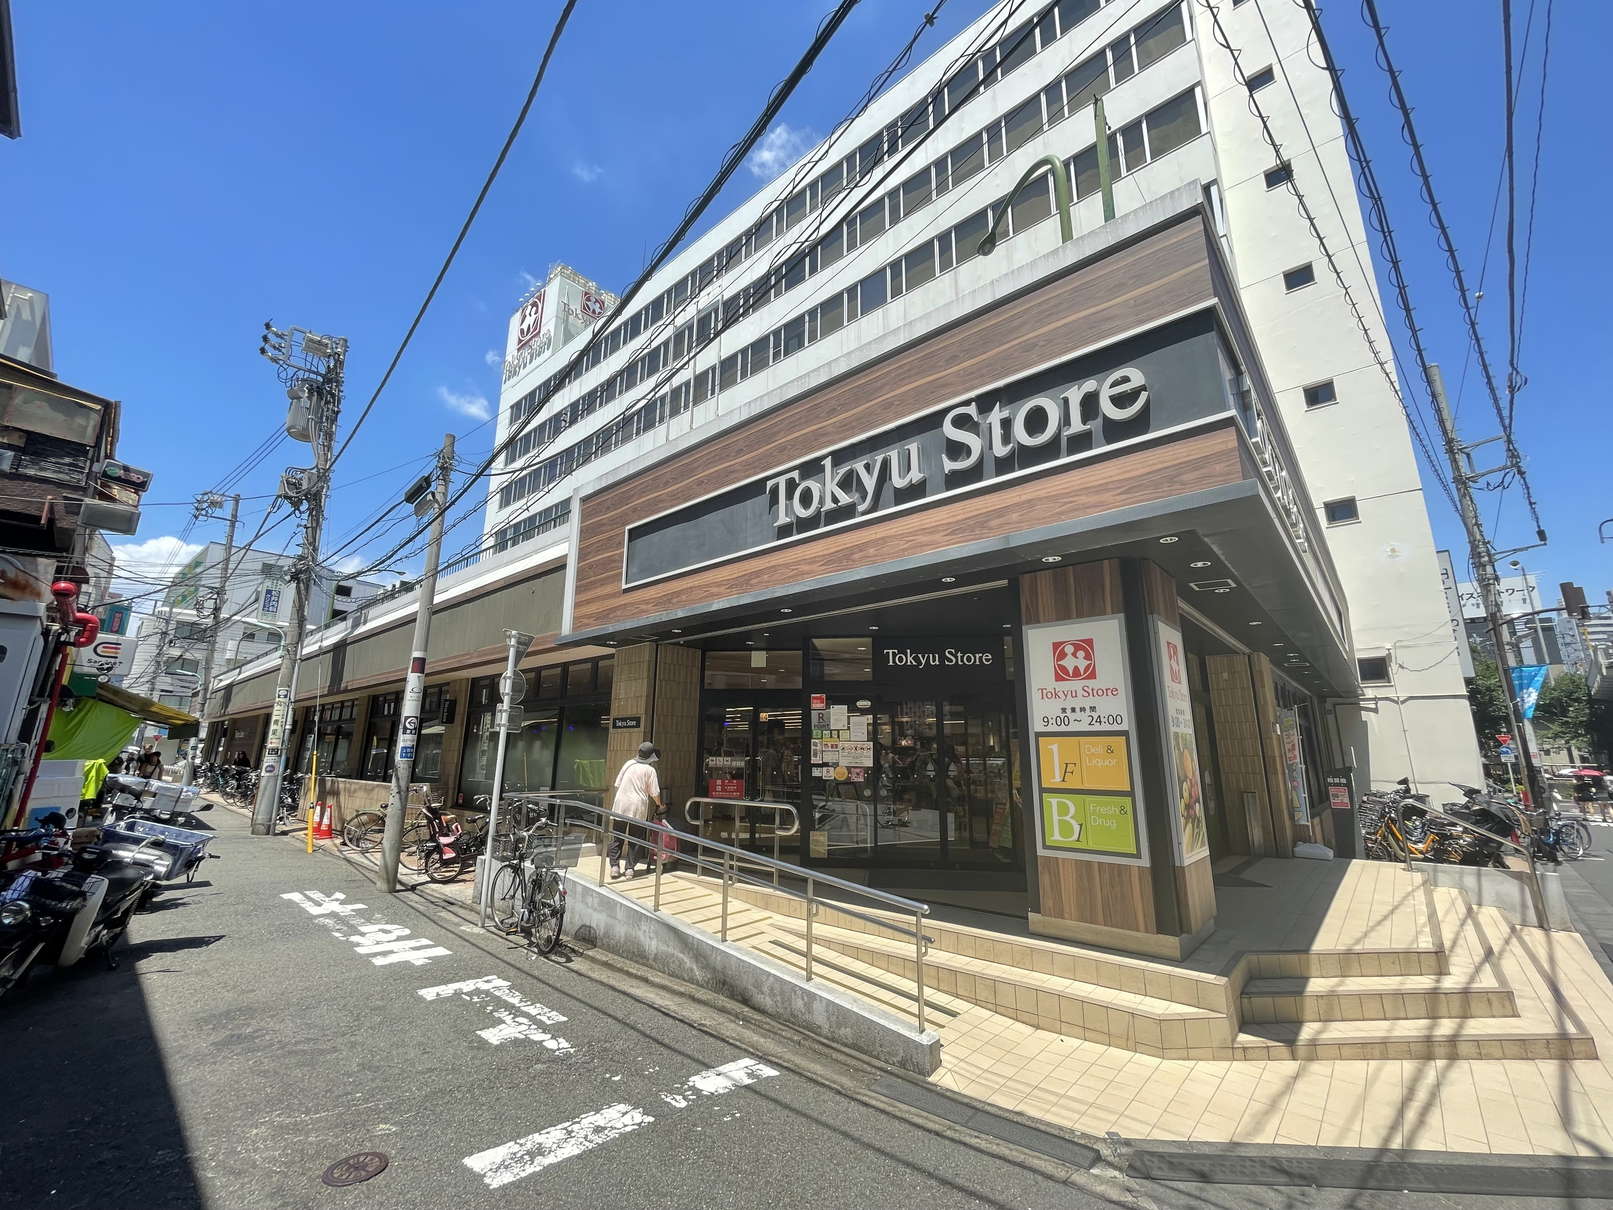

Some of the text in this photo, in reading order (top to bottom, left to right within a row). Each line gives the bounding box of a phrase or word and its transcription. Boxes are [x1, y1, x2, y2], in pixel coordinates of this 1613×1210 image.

[766, 367, 1149, 527] Tokyu Store
[883, 648, 993, 669] Tokyu Store
[1037, 685, 1119, 701] Tokyu Store
[1060, 705, 1097, 714] 営業時間
[615, 719, 637, 728] Tokyu Store
[1042, 715, 1070, 727] 9:00
[1087, 713, 1123, 726] 24:00
[1085, 744, 1115, 754] Deli &
[1086, 757, 1118, 768] Liquor
[1090, 803, 1128, 815] Fresh &
[1091, 816, 1117, 829] Drug
